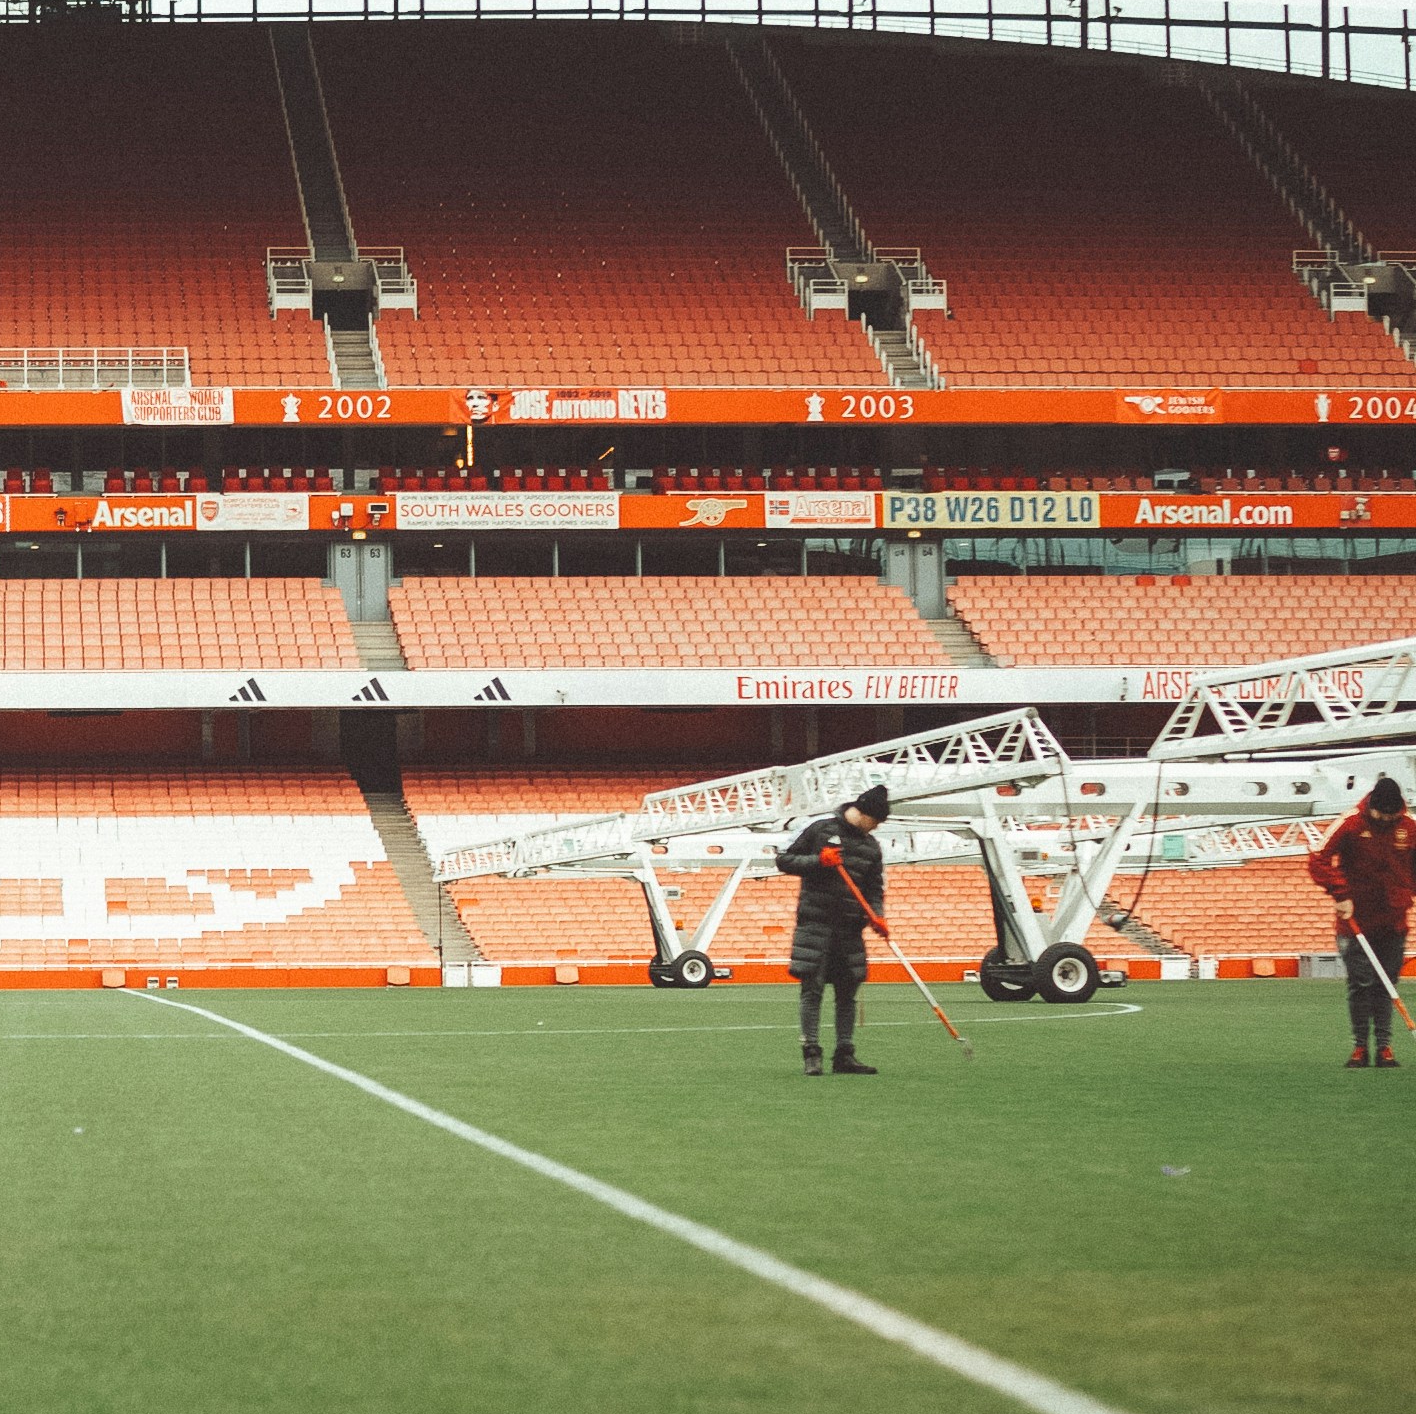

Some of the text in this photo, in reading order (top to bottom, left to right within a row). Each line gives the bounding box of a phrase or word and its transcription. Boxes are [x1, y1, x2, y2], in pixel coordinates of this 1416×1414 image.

[131, 390, 224, 405] ARSENAL WOMEN
[318, 395, 391, 419] 2002
[551, 399, 617, 419] ANTONIO
[618, 389, 667, 419] REYES
[841, 395, 914, 419] 2003
[1168, 396, 1205, 405] JEWISH
[1348, 396, 1416, 419] 2004
[134, 406, 222, 421] SUPPORTERS CLUB
[91, 499, 193, 527] Arsenal
[400, 503, 615, 518] SOUTH WALES GOONERS
[793, 495, 872, 517] Arsenal
[890, 496, 936, 523] P38
[946, 496, 1000, 523] W26
[1010, 496, 1057, 523] D12
[1134, 498, 1293, 525] Arsenal.com
[340, 548, 352, 559] 63
[370, 548, 381, 559] 63
[736, 675, 959, 700] Emirates FLY BETTER
